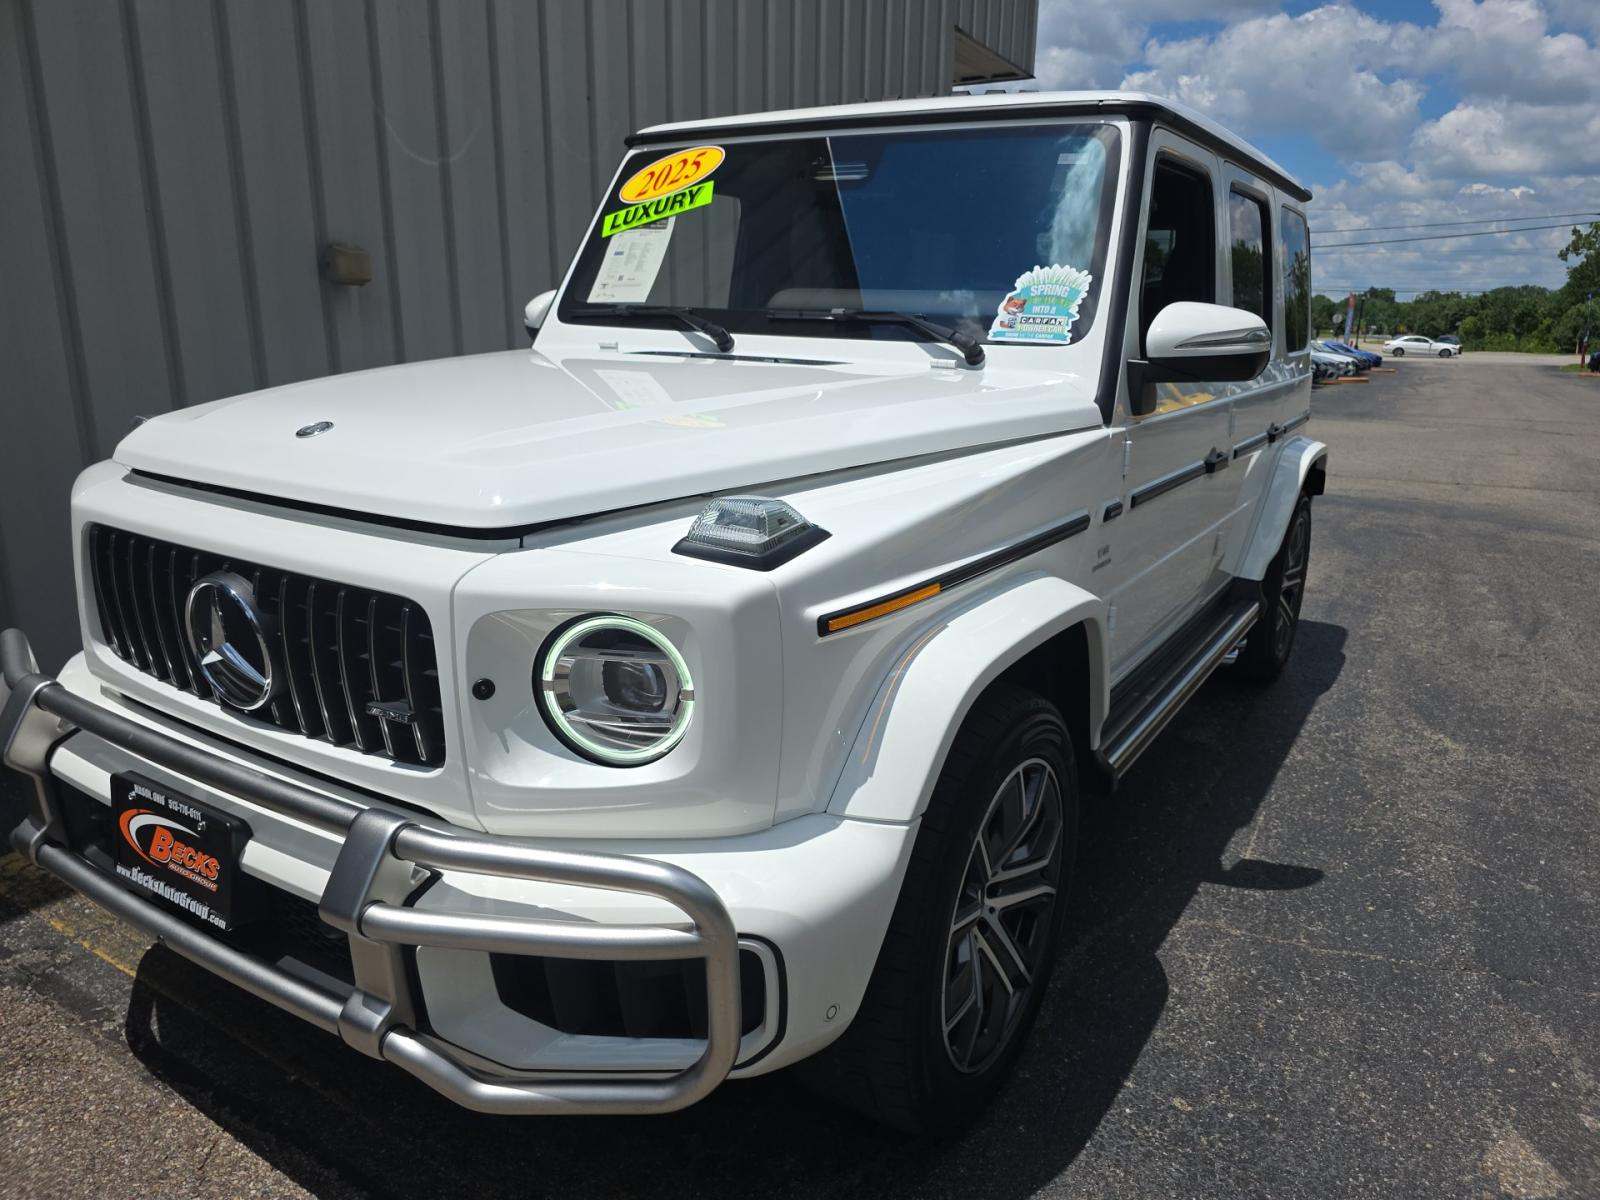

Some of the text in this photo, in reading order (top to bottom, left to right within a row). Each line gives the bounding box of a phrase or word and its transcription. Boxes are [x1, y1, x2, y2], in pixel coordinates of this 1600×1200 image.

[635, 151, 708, 198] 2025
[610, 186, 704, 231] LUXURY
[1030, 283, 1070, 298] SPRING
[1020, 316, 1064, 326] CARFAX
[149, 825, 220, 881] BECKS
[116, 864, 226, 931] www.BecksAutoGroup.com
